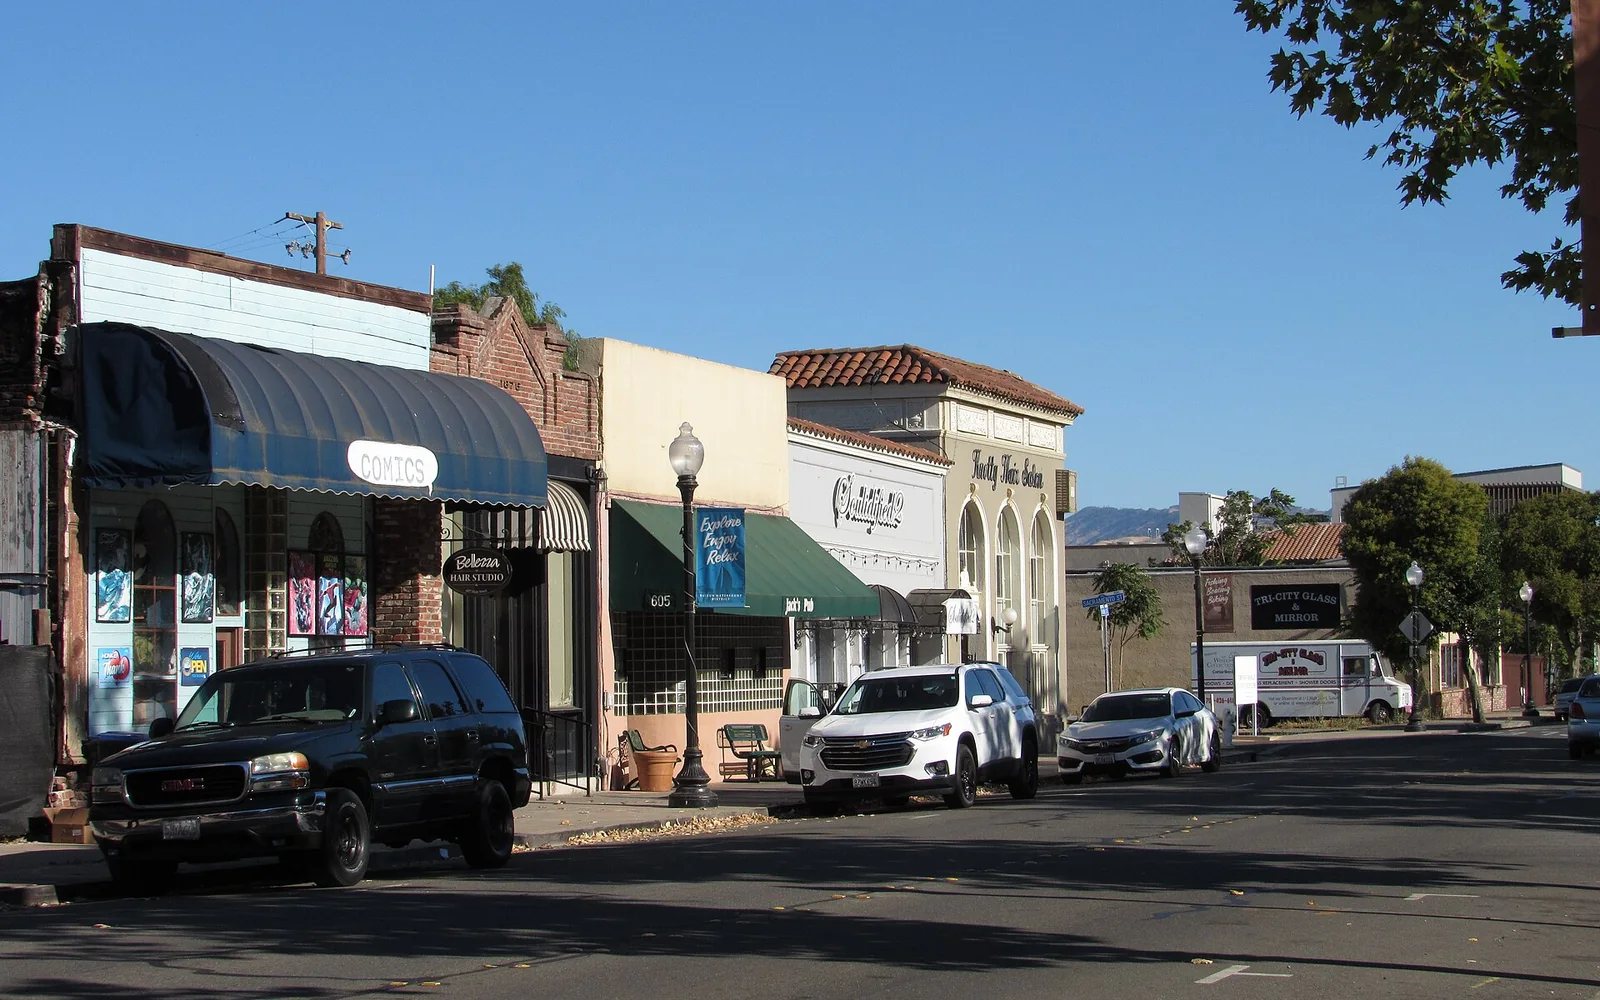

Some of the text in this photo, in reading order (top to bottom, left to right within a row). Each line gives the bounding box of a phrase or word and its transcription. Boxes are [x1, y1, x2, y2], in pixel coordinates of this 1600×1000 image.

[361, 453, 424, 484] COMICS
[972, 449, 1044, 492] Knotty Hair Salon
[700, 515, 741, 533] Explore
[703, 532, 737, 550] Enjoy
[455, 553, 500, 570] Bellezza
[706, 549, 738, 566] Relax
[450, 573, 504, 582] HAIR STUDIO
[1207, 586, 1231, 596] Boating
[1254, 591, 1337, 606] TRI-CITY GLASS
[651, 594, 671, 607] 605
[803, 597, 815, 613] Pub
[1208, 595, 1229, 605] Biking
[1292, 602, 1300, 611] &
[1274, 613, 1320, 622] MIRROR
[1262, 648, 1324, 667] TRI-CITY GLASS
[1278, 666, 1309, 677] MIRROR
[161, 777, 205, 791] GMC
